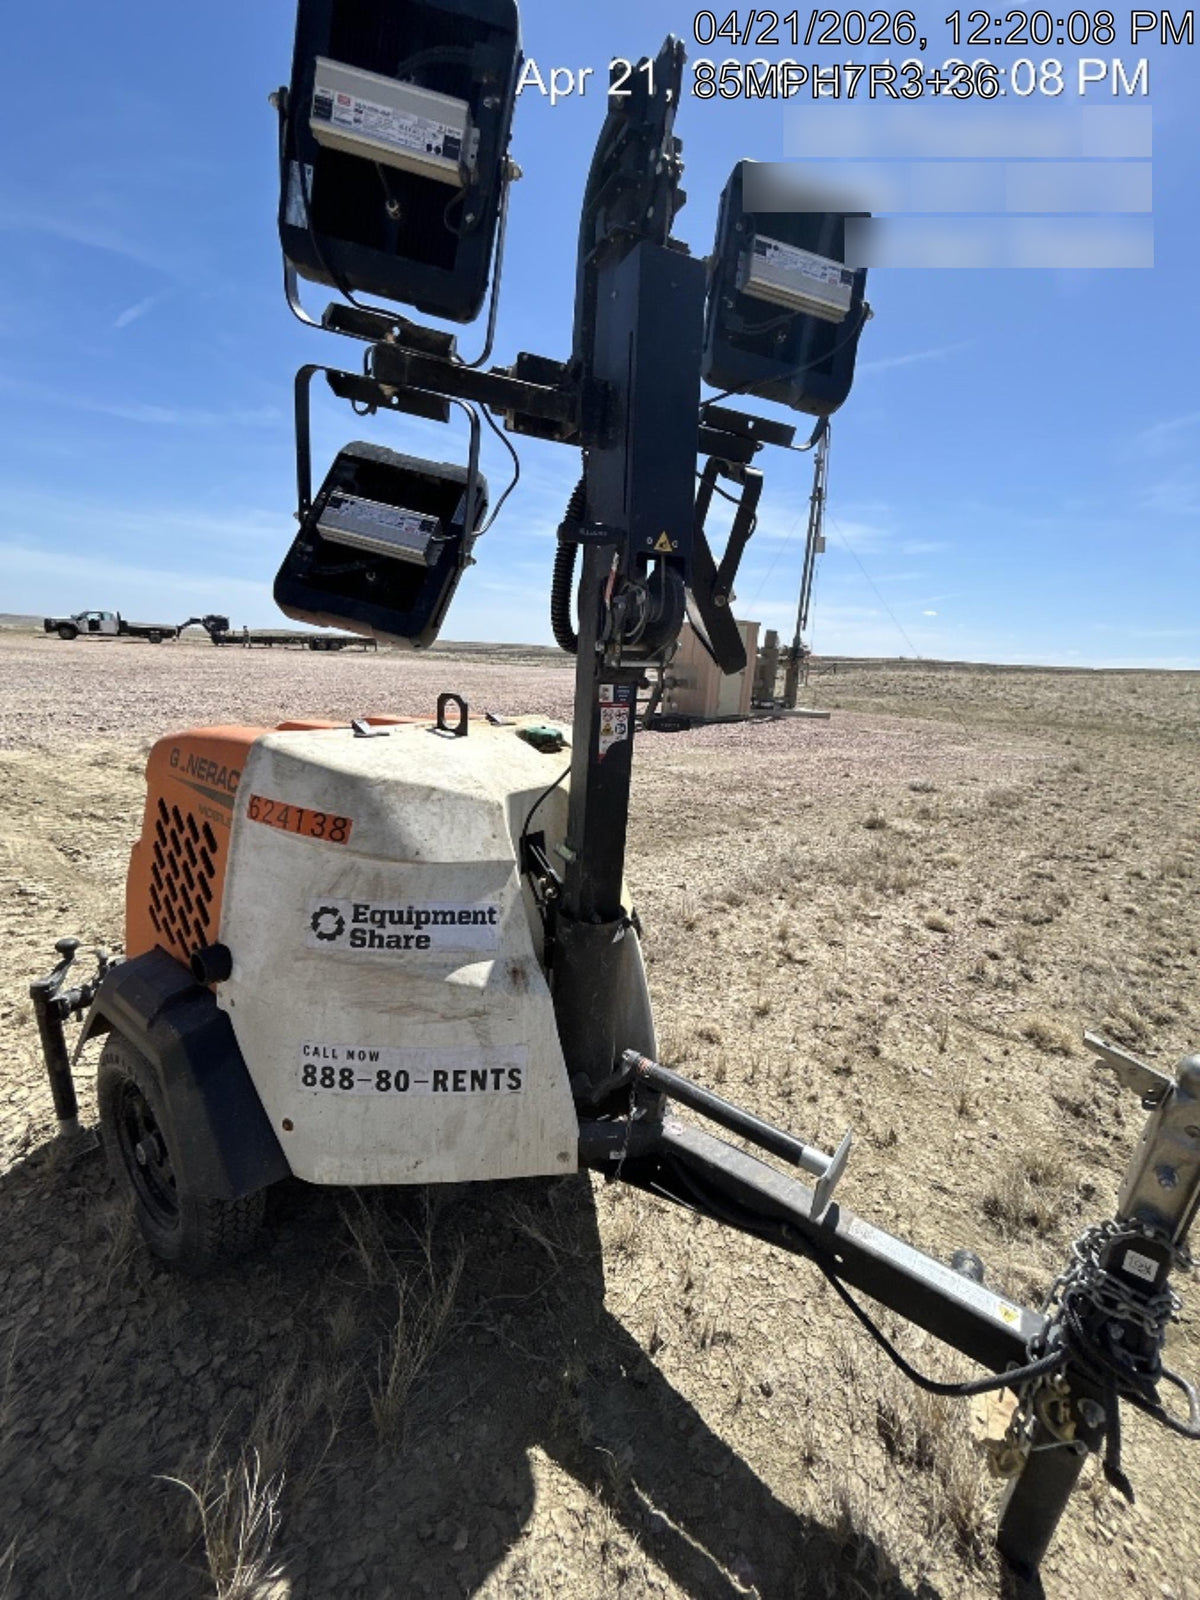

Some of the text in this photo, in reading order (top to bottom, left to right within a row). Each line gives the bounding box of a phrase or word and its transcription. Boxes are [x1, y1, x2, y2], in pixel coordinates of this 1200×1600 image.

[170, 747, 240, 794] GNERAC
[248, 795, 348, 842] 624138
[352, 903, 497, 930] Equipment
[350, 928, 431, 950] Share
[303, 1044, 380, 1062] CALL NOW
[302, 1064, 523, 1093] 888-80-RENTS
